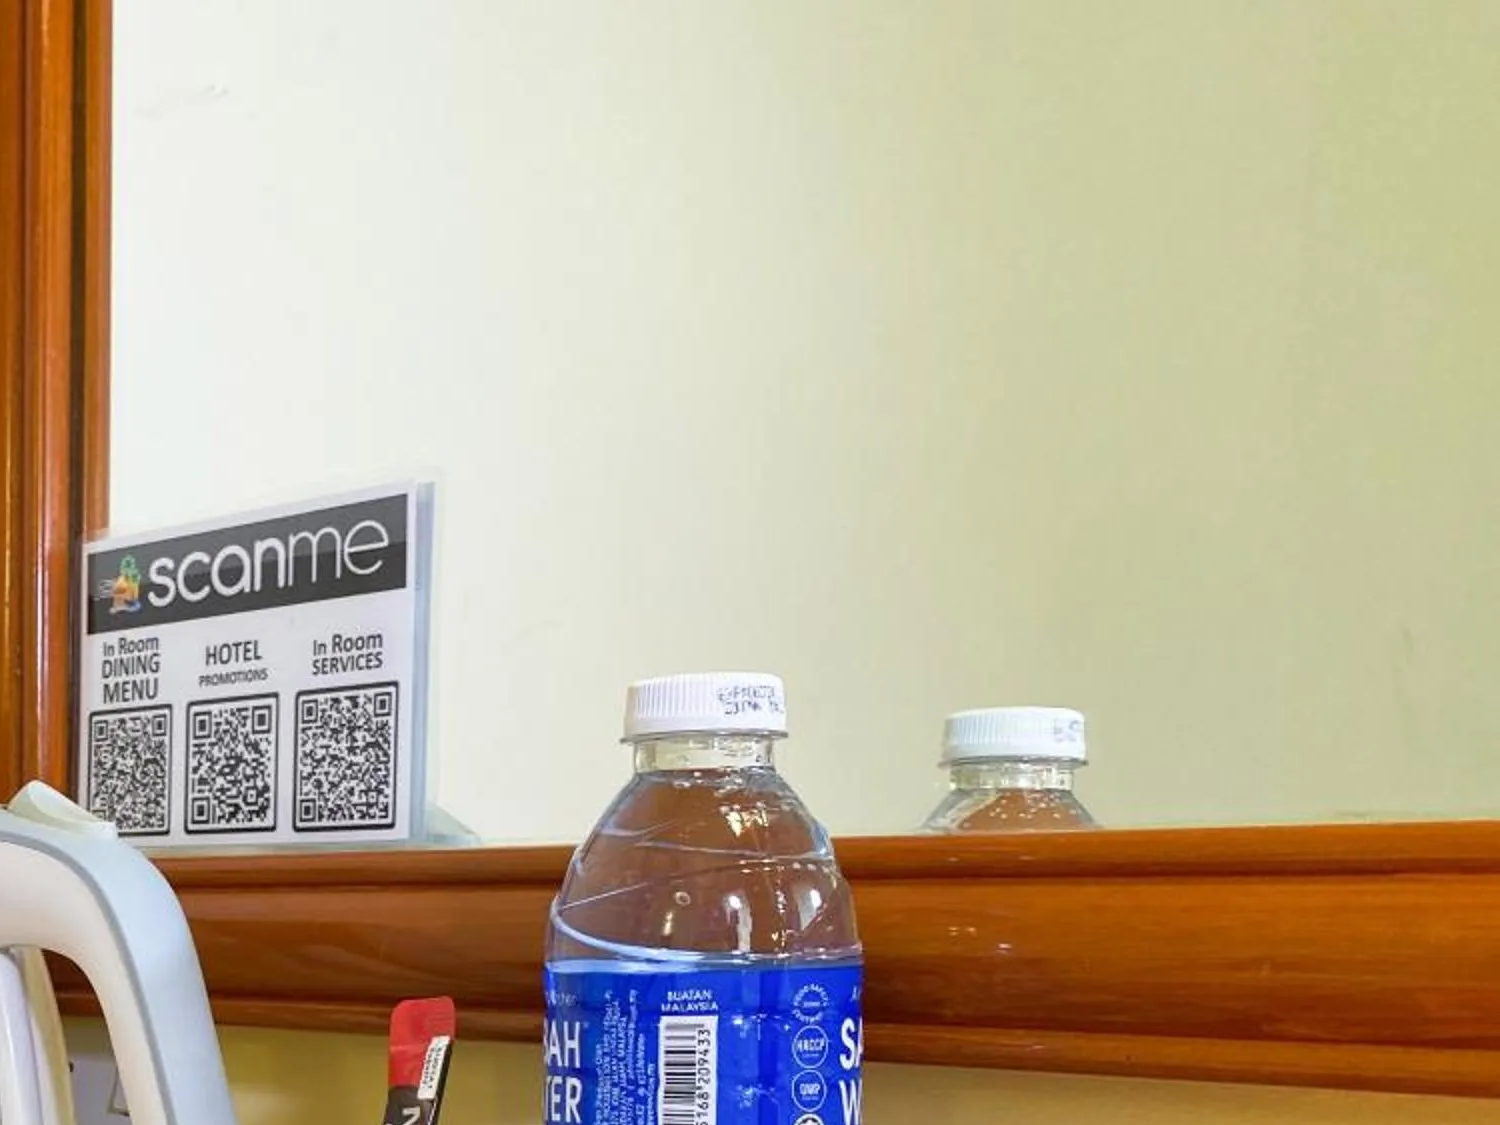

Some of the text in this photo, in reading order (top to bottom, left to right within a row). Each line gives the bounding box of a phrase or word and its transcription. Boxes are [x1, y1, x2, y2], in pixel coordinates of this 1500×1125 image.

[103, 636, 159, 657] In Room
[205, 639, 263, 666] HOTEL
[312, 633, 383, 656] In Room
[102, 653, 161, 679] DINING
[312, 651, 383, 676] SERVICES
[198, 667, 269, 688] PROMOTIONS
[103, 677, 159, 704] MENU
[661, 1002, 719, 1013] MALAYSIA
[544, 1017, 581, 1069] AH
